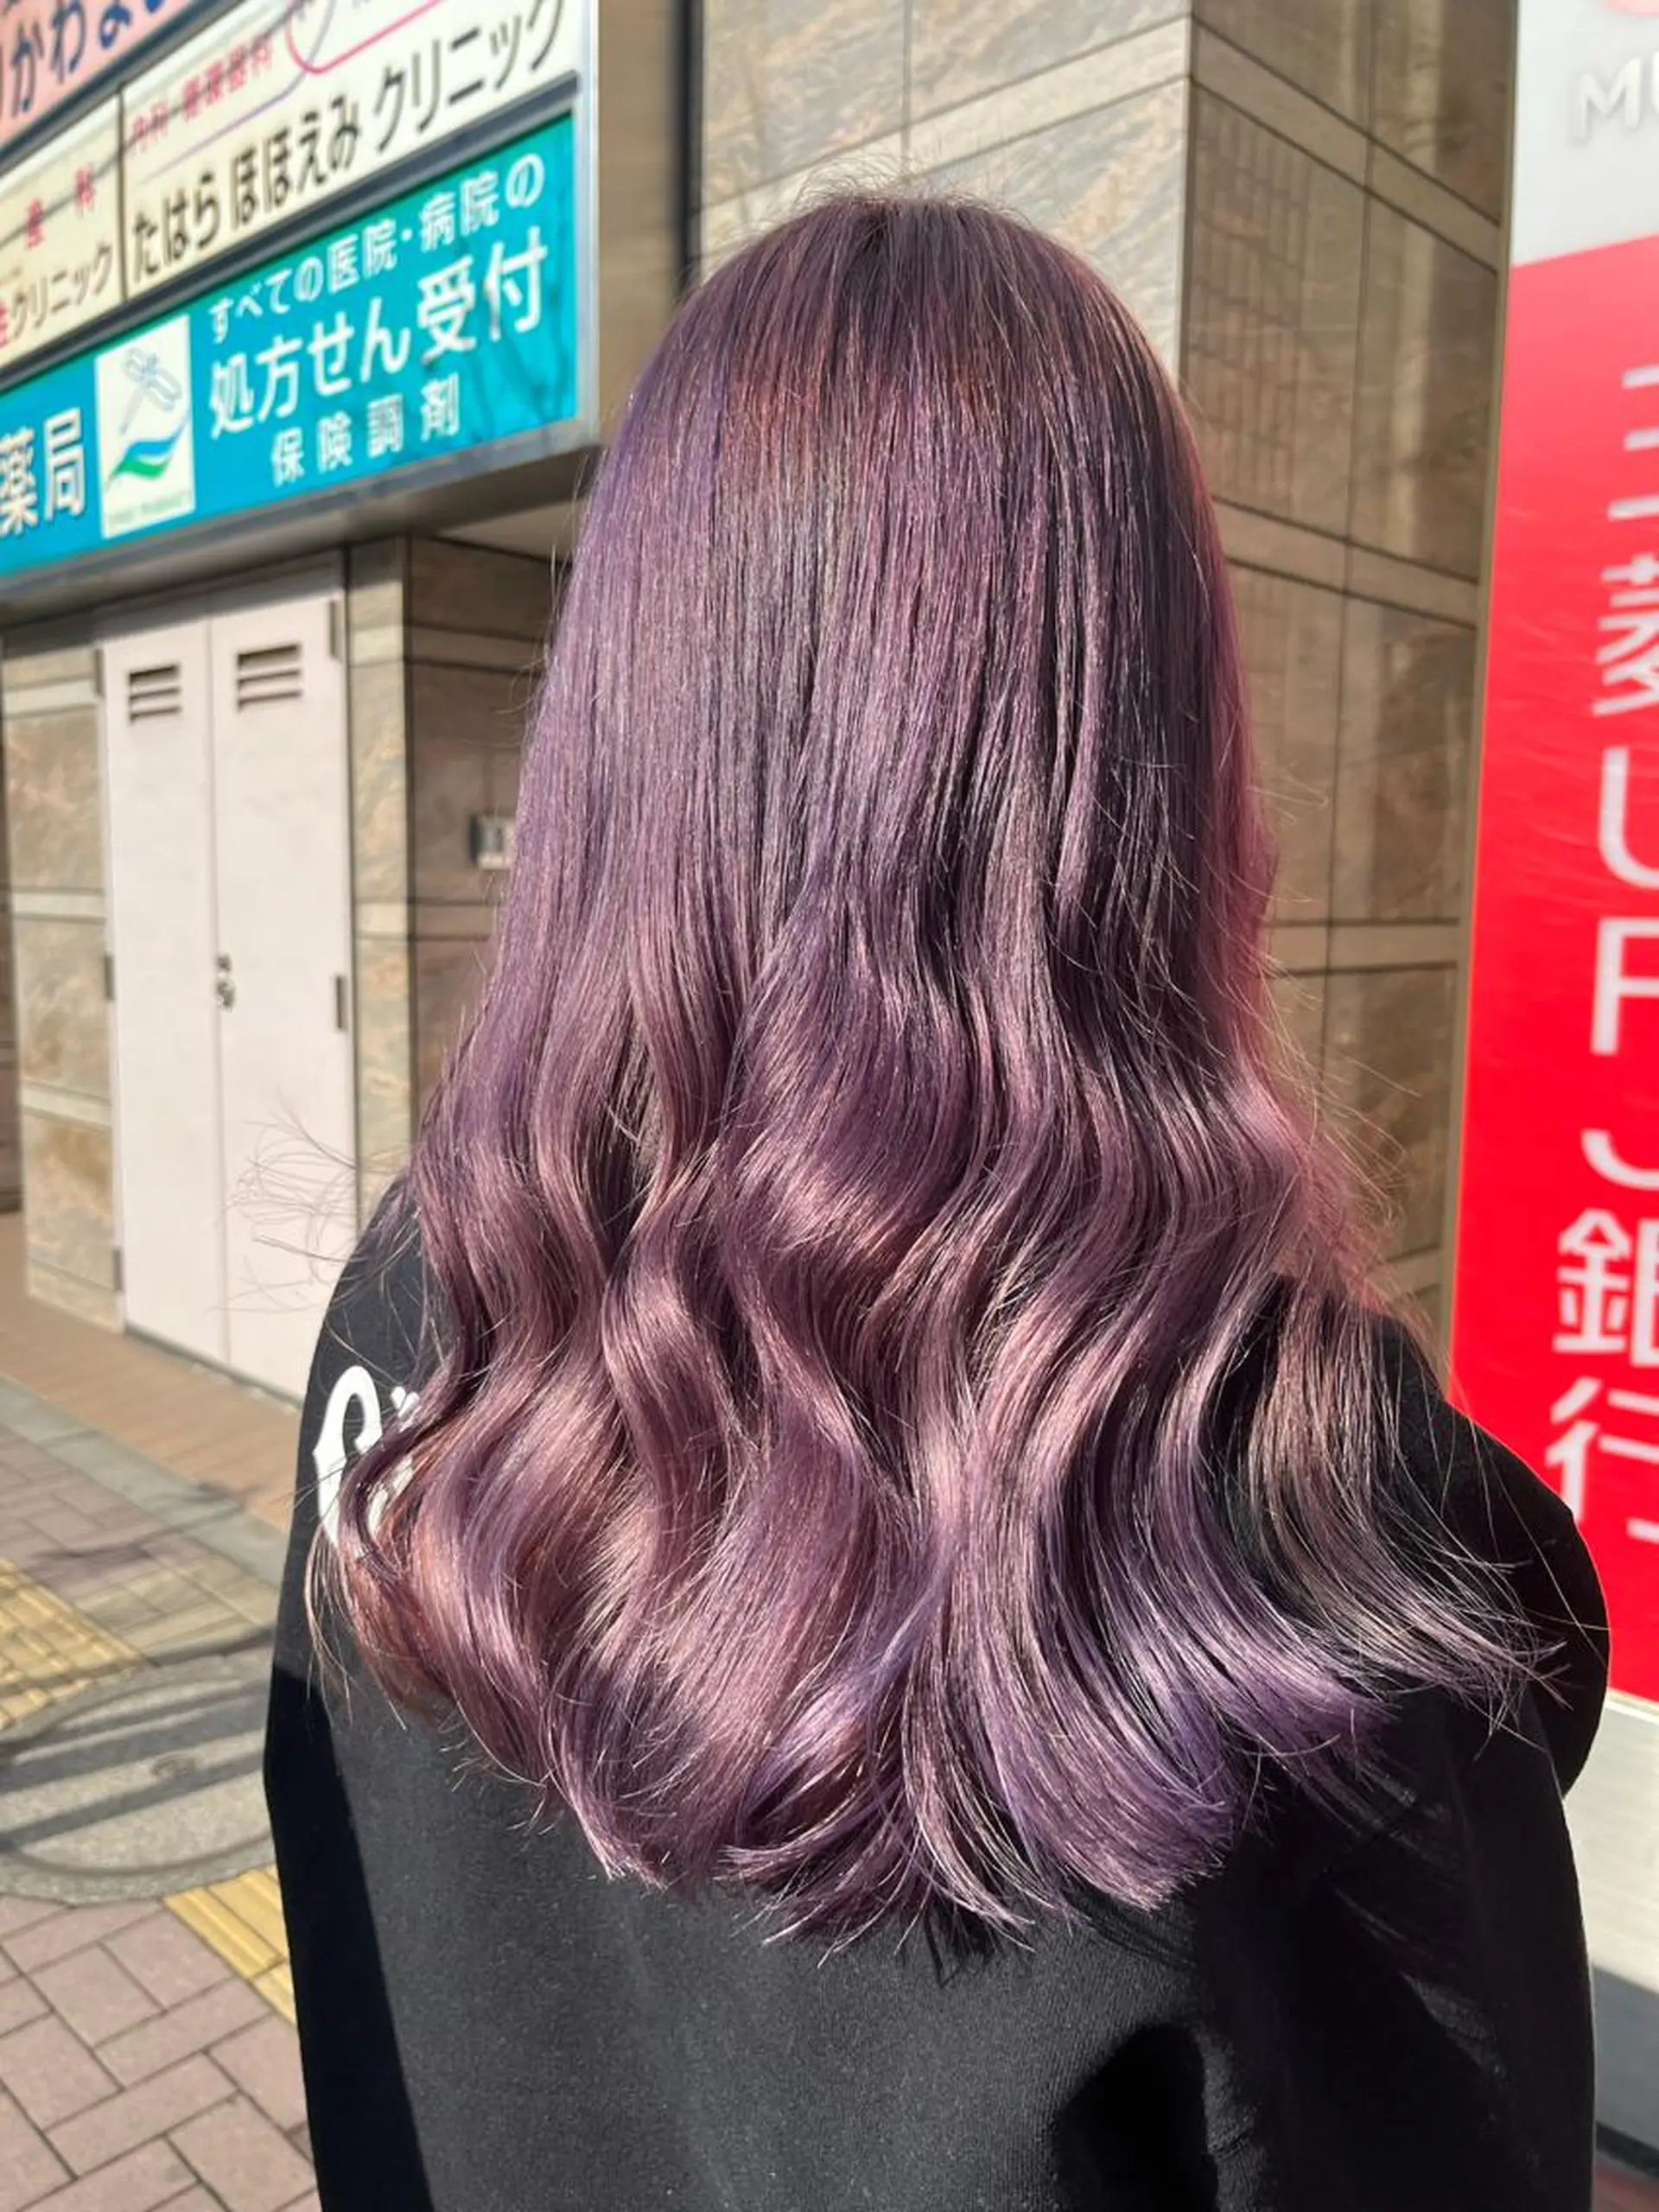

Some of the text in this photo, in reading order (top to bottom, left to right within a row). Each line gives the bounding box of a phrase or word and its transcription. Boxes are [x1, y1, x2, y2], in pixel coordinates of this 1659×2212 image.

[0, 241, 112, 345] クリニック
[209, 154, 545, 343] すべての医院・病院の
[209, 225, 548, 439] 処方せん受付
[270, 373, 460, 486] 保険調剤
